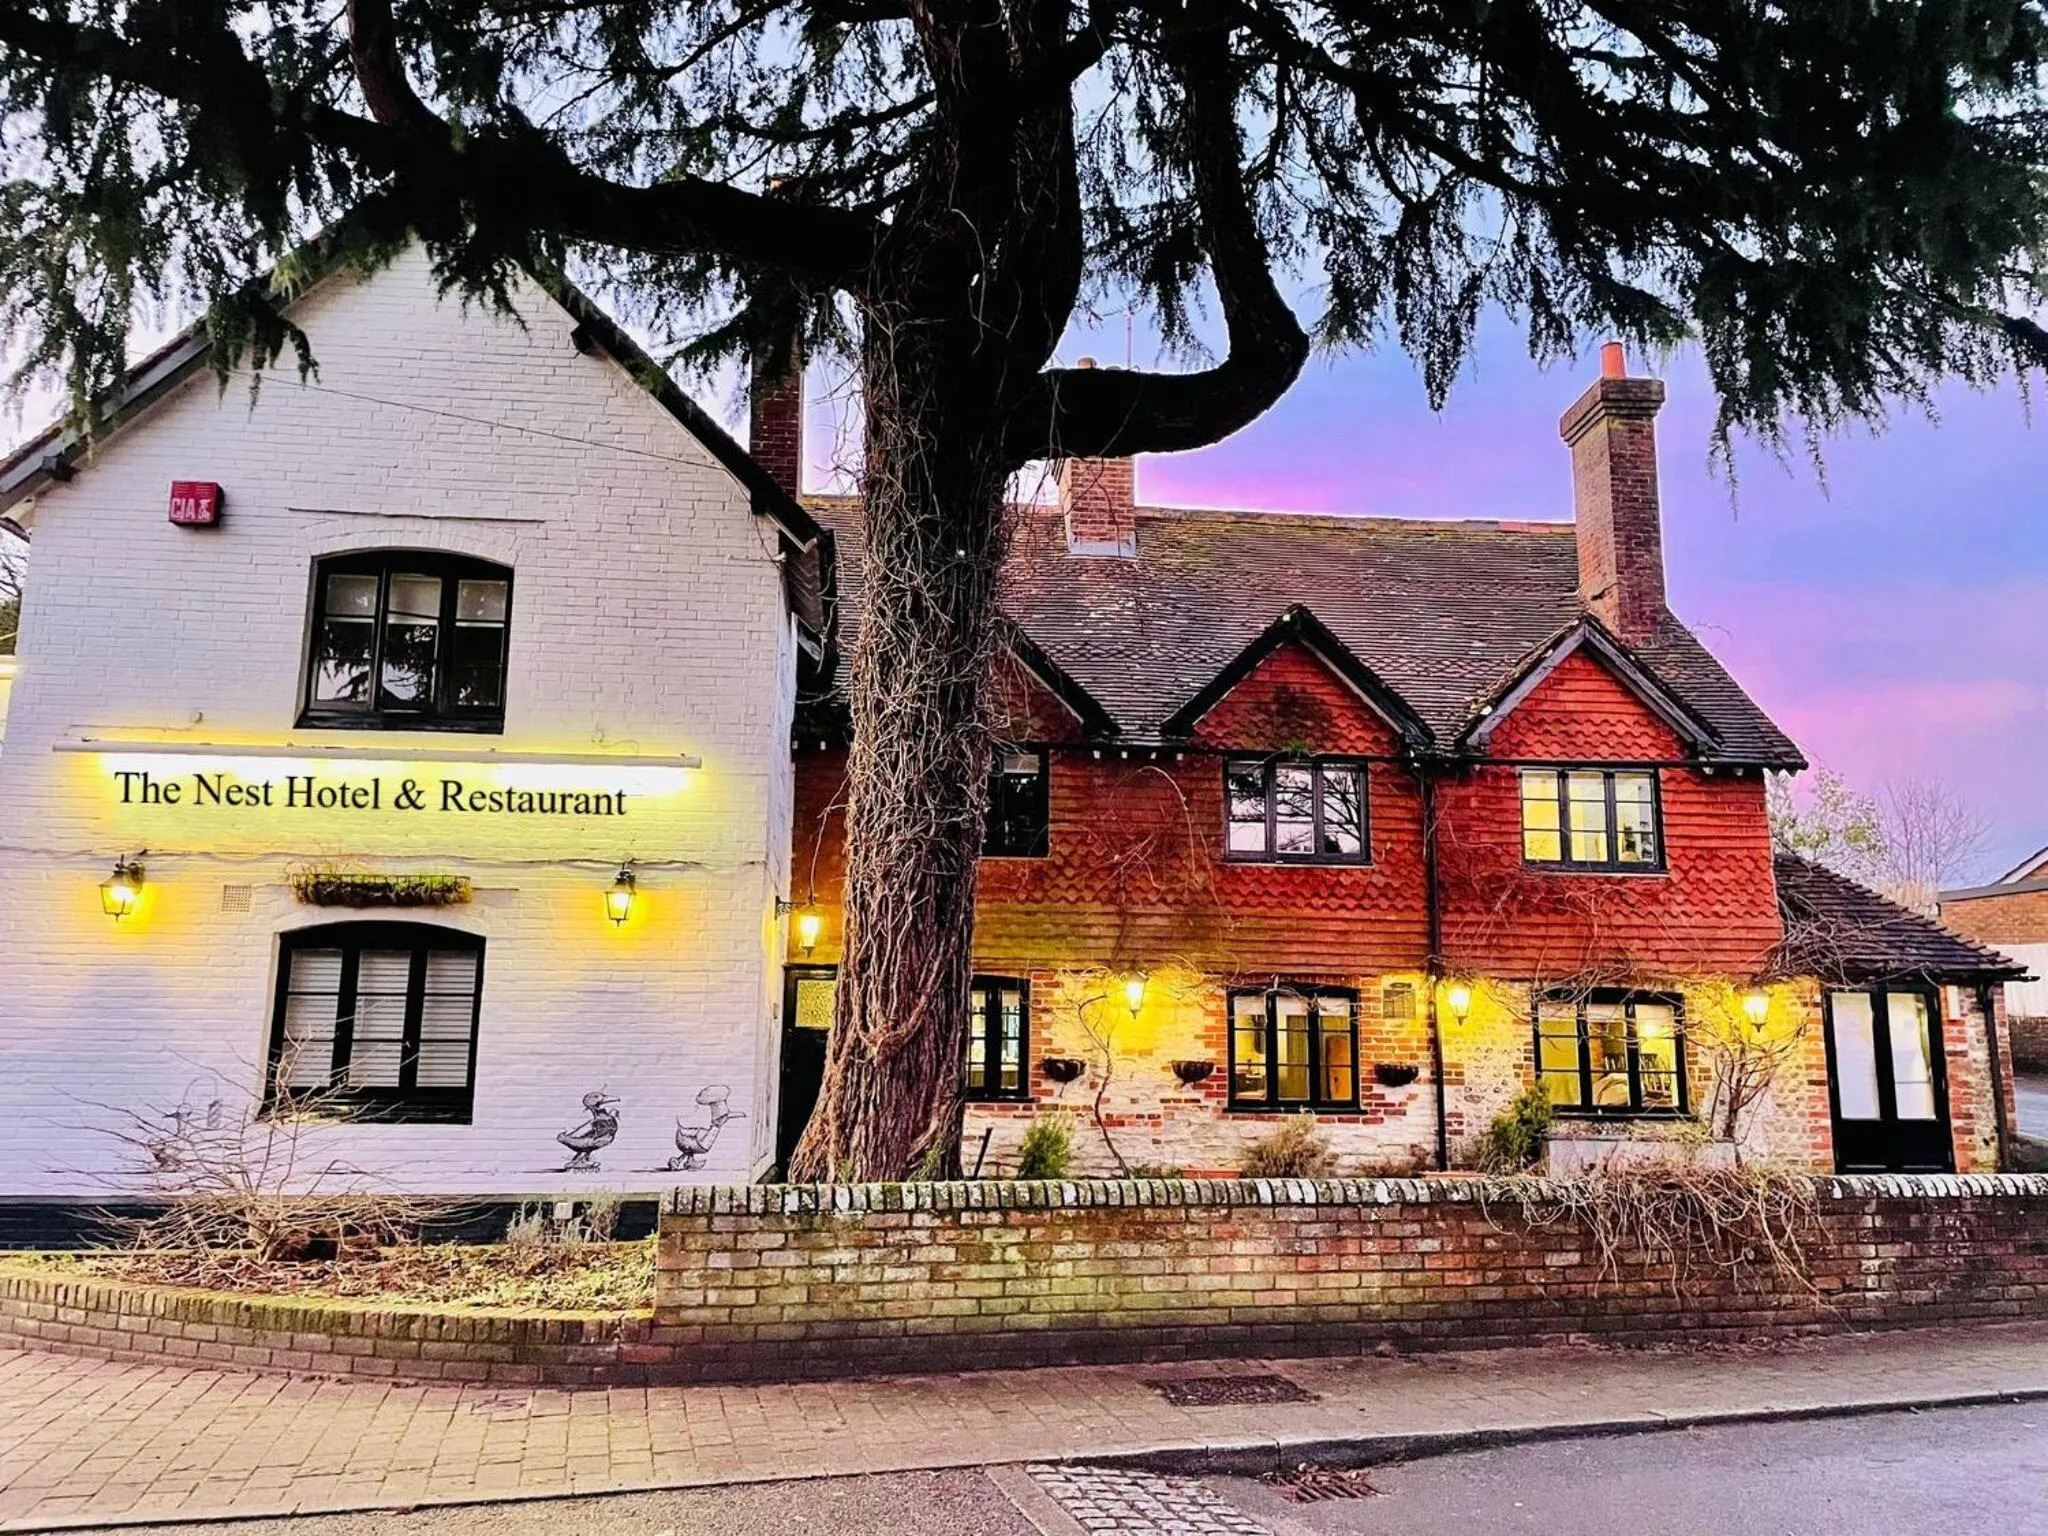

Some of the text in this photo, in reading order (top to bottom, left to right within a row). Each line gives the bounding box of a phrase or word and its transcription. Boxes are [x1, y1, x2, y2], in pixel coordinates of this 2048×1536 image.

[114, 771, 626, 816] The Nest Hotel & Restaurant
